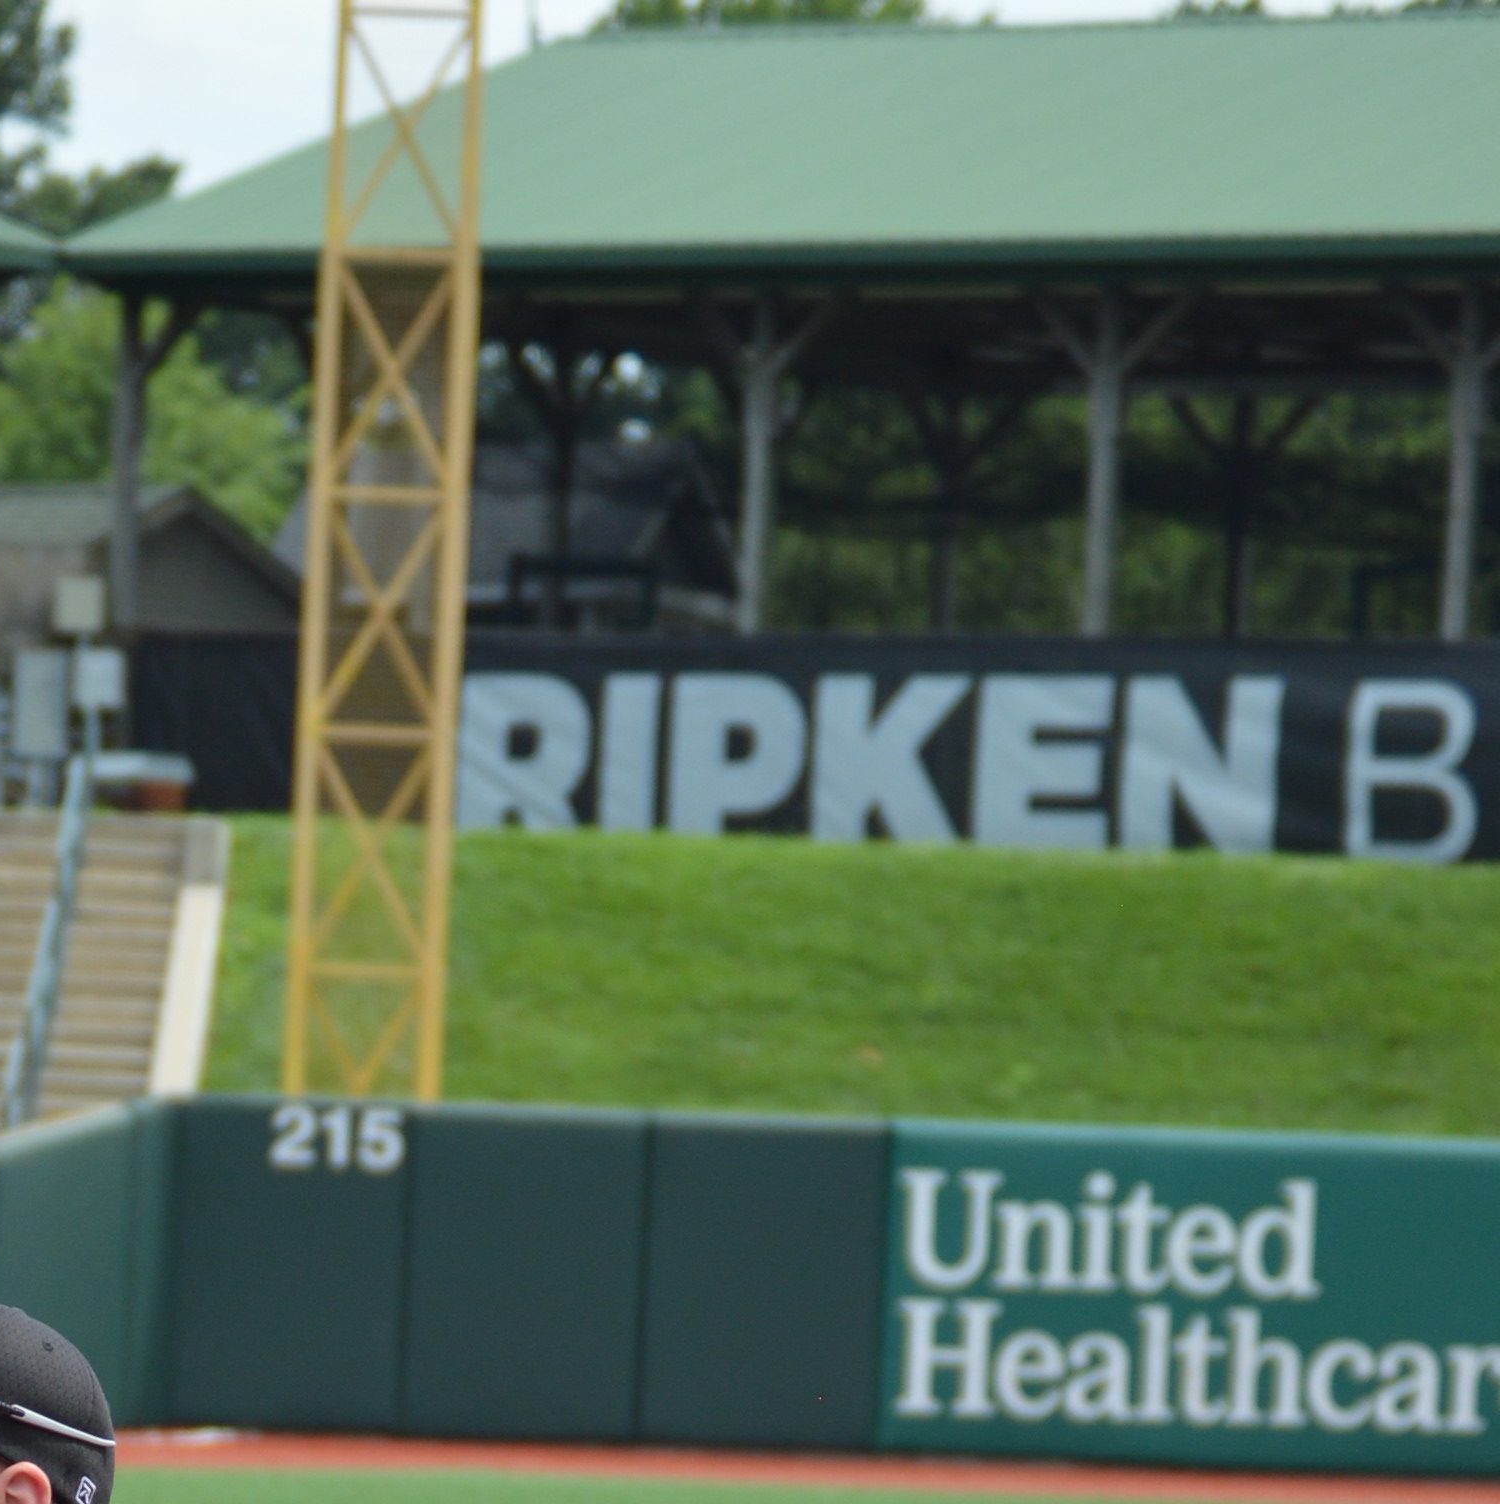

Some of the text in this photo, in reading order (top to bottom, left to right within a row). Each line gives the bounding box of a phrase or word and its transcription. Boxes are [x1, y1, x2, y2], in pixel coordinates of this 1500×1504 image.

[457, 671, 1286, 855] RIPKEN
[268, 1103, 407, 1175] 215
[897, 1166, 1322, 1300] United
[896, 1297, 1500, 1434] Healthcar
